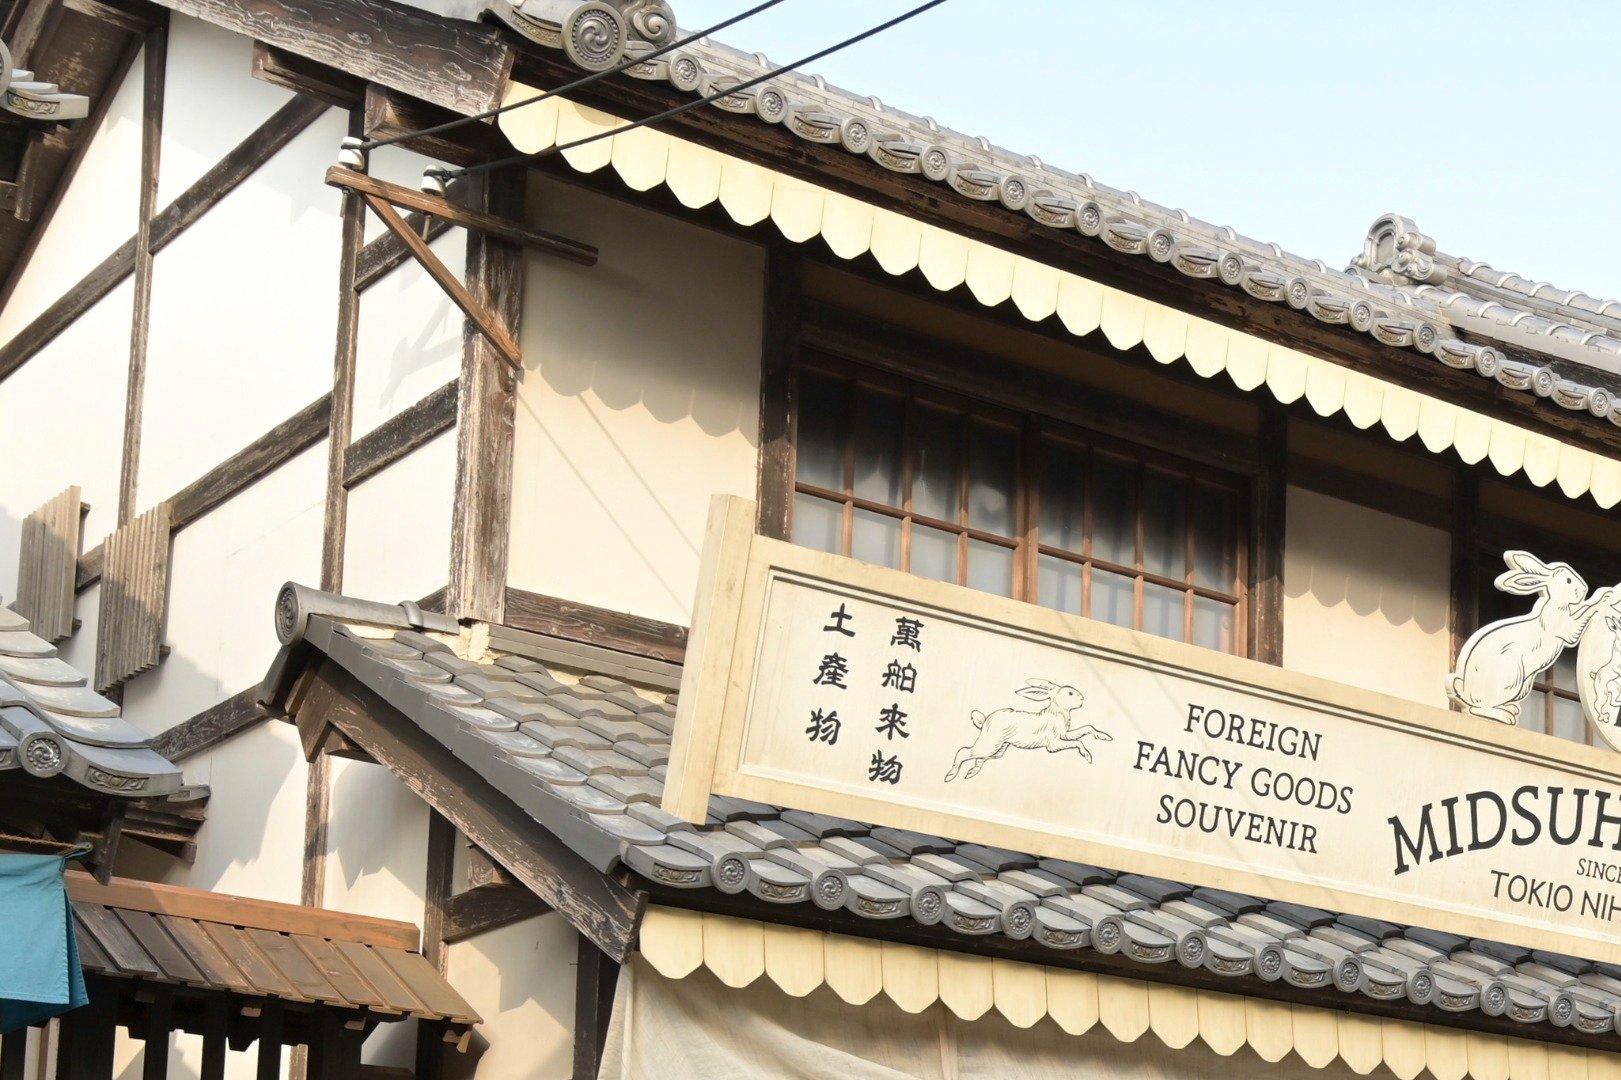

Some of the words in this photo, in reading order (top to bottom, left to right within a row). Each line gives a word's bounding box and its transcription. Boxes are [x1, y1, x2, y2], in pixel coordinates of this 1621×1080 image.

[806, 602, 856, 746] 土産物
[1183, 703, 1323, 762] FOREIGN
[1134, 740, 1243, 790] FANCY
[1250, 767, 1354, 815] GOODS
[1156, 794, 1318, 854] SOUVENIR
[1490, 869, 1574, 912] TOKIO
